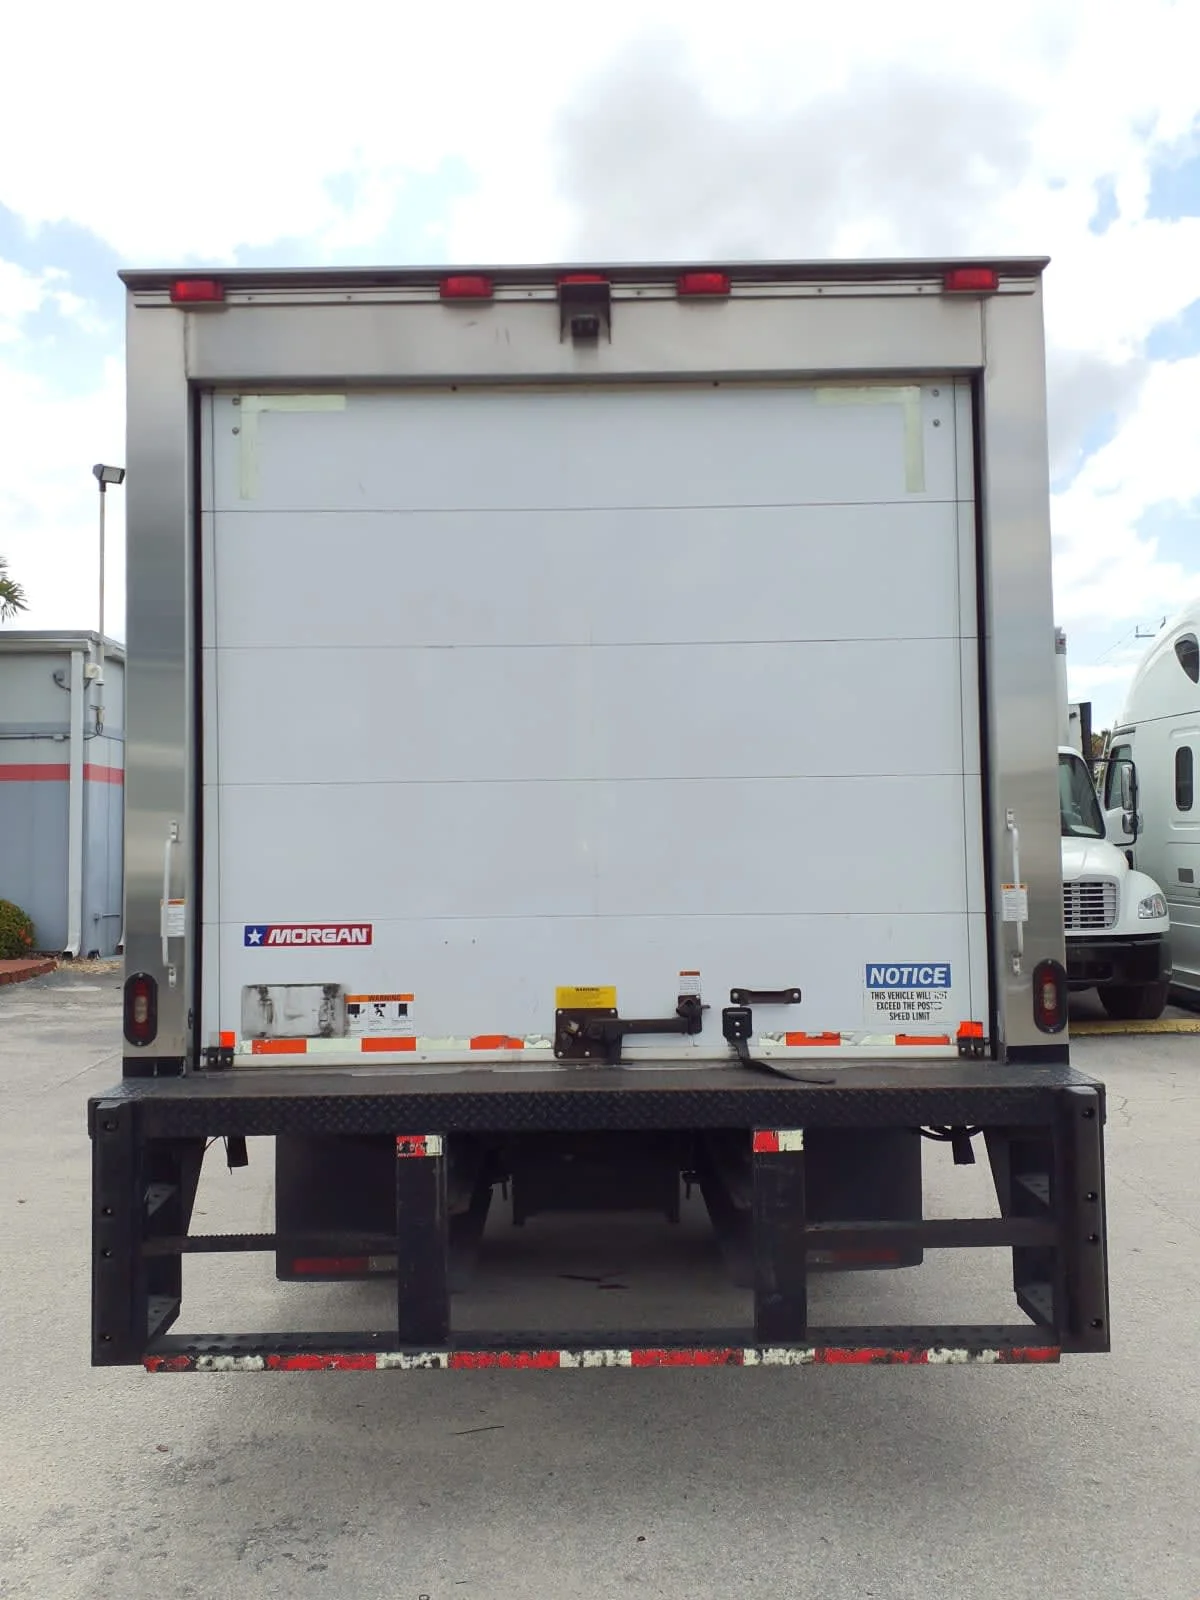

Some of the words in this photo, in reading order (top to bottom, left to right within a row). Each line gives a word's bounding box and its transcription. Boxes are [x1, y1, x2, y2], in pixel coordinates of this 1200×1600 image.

[268, 928, 367, 944] MORGAN
[869, 967, 947, 985] NOTICE
[368, 994, 401, 1002] WARNING
[871, 991, 886, 1000] THIS
[887, 991, 915, 1000] VEHICLE
[876, 1001, 901, 1010] EXCEED
[903, 1001, 915, 1010] THE
[889, 1011, 910, 1020] SPEED
[912, 1011, 930, 1020] LIMIT
